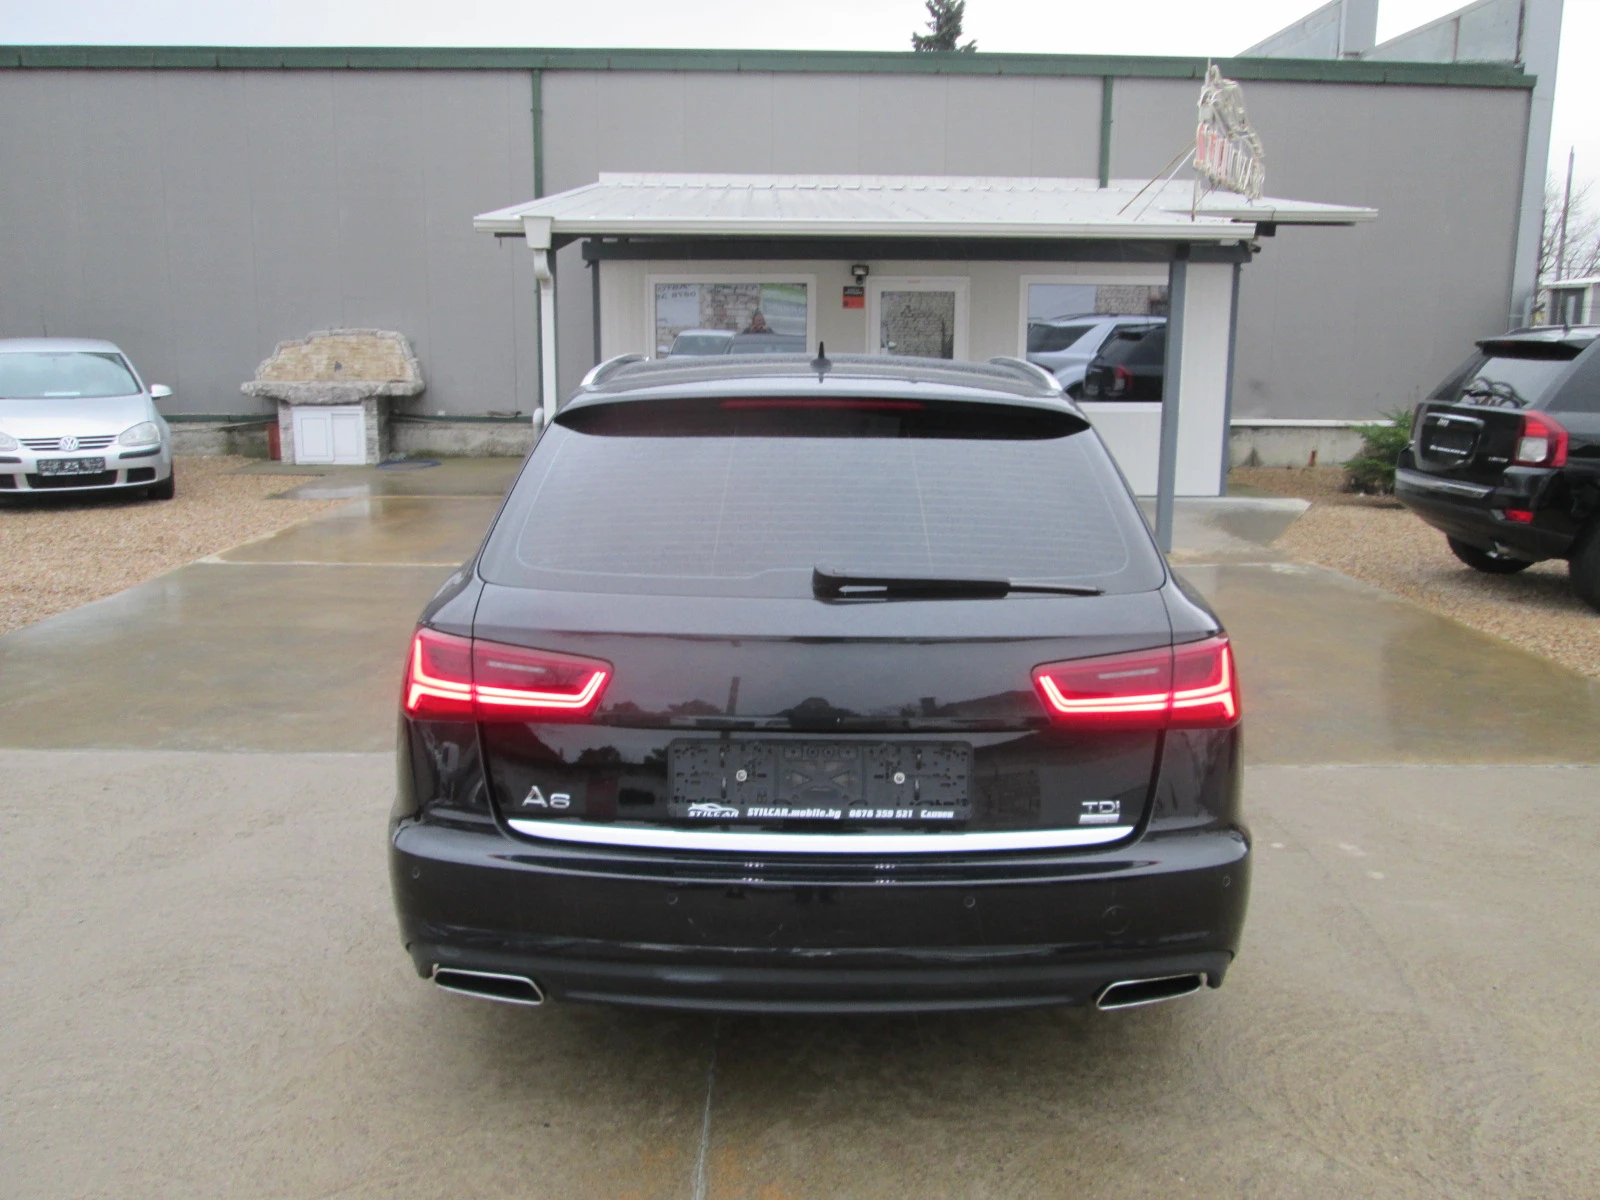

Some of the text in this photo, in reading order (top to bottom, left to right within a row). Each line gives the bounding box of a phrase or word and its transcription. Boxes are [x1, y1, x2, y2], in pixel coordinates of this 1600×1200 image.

[521, 785, 570, 809] A6
[688, 810, 739, 818] STILCAR
[747, 807, 842, 820] STILCAR.mobile.bg
